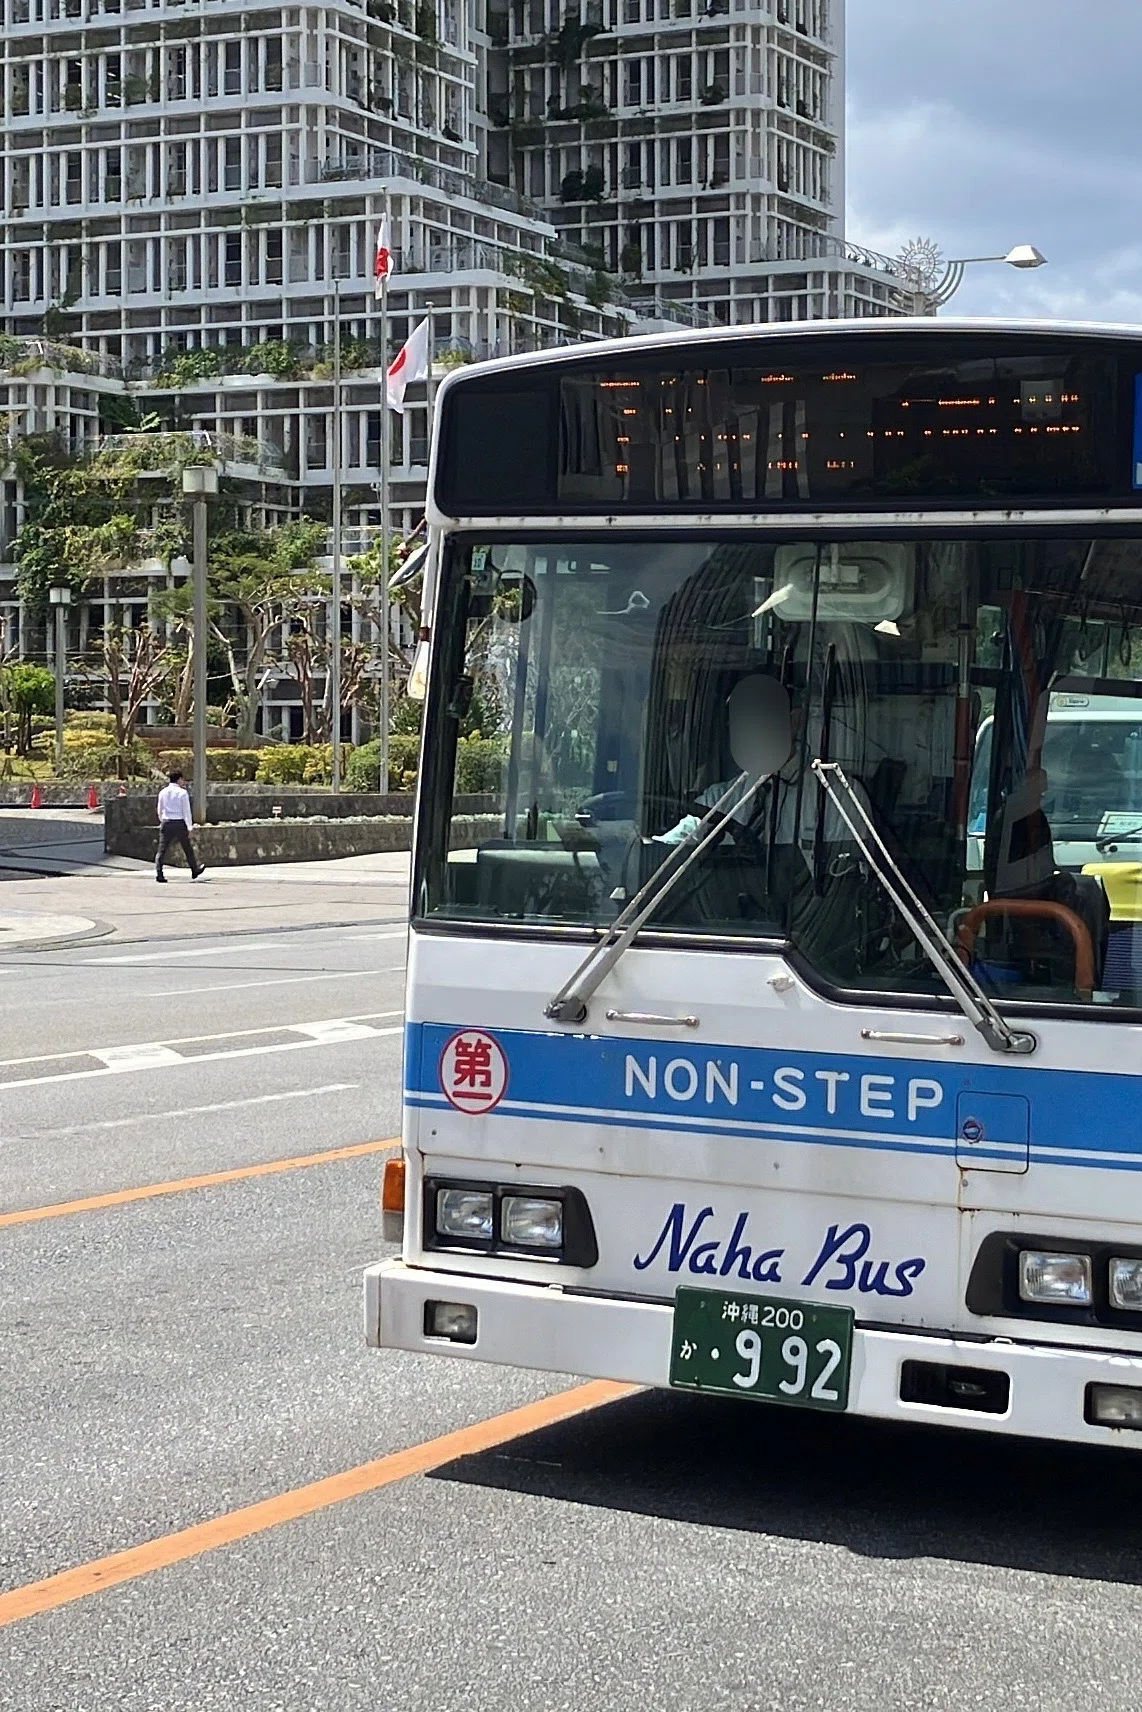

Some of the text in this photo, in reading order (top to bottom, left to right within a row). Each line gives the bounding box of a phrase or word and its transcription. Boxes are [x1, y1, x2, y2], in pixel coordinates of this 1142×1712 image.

[624, 1054, 943, 1121] NON-STEP
[633, 1203, 927, 1298] Naha Bus
[679, 1339, 698, 1361] か
